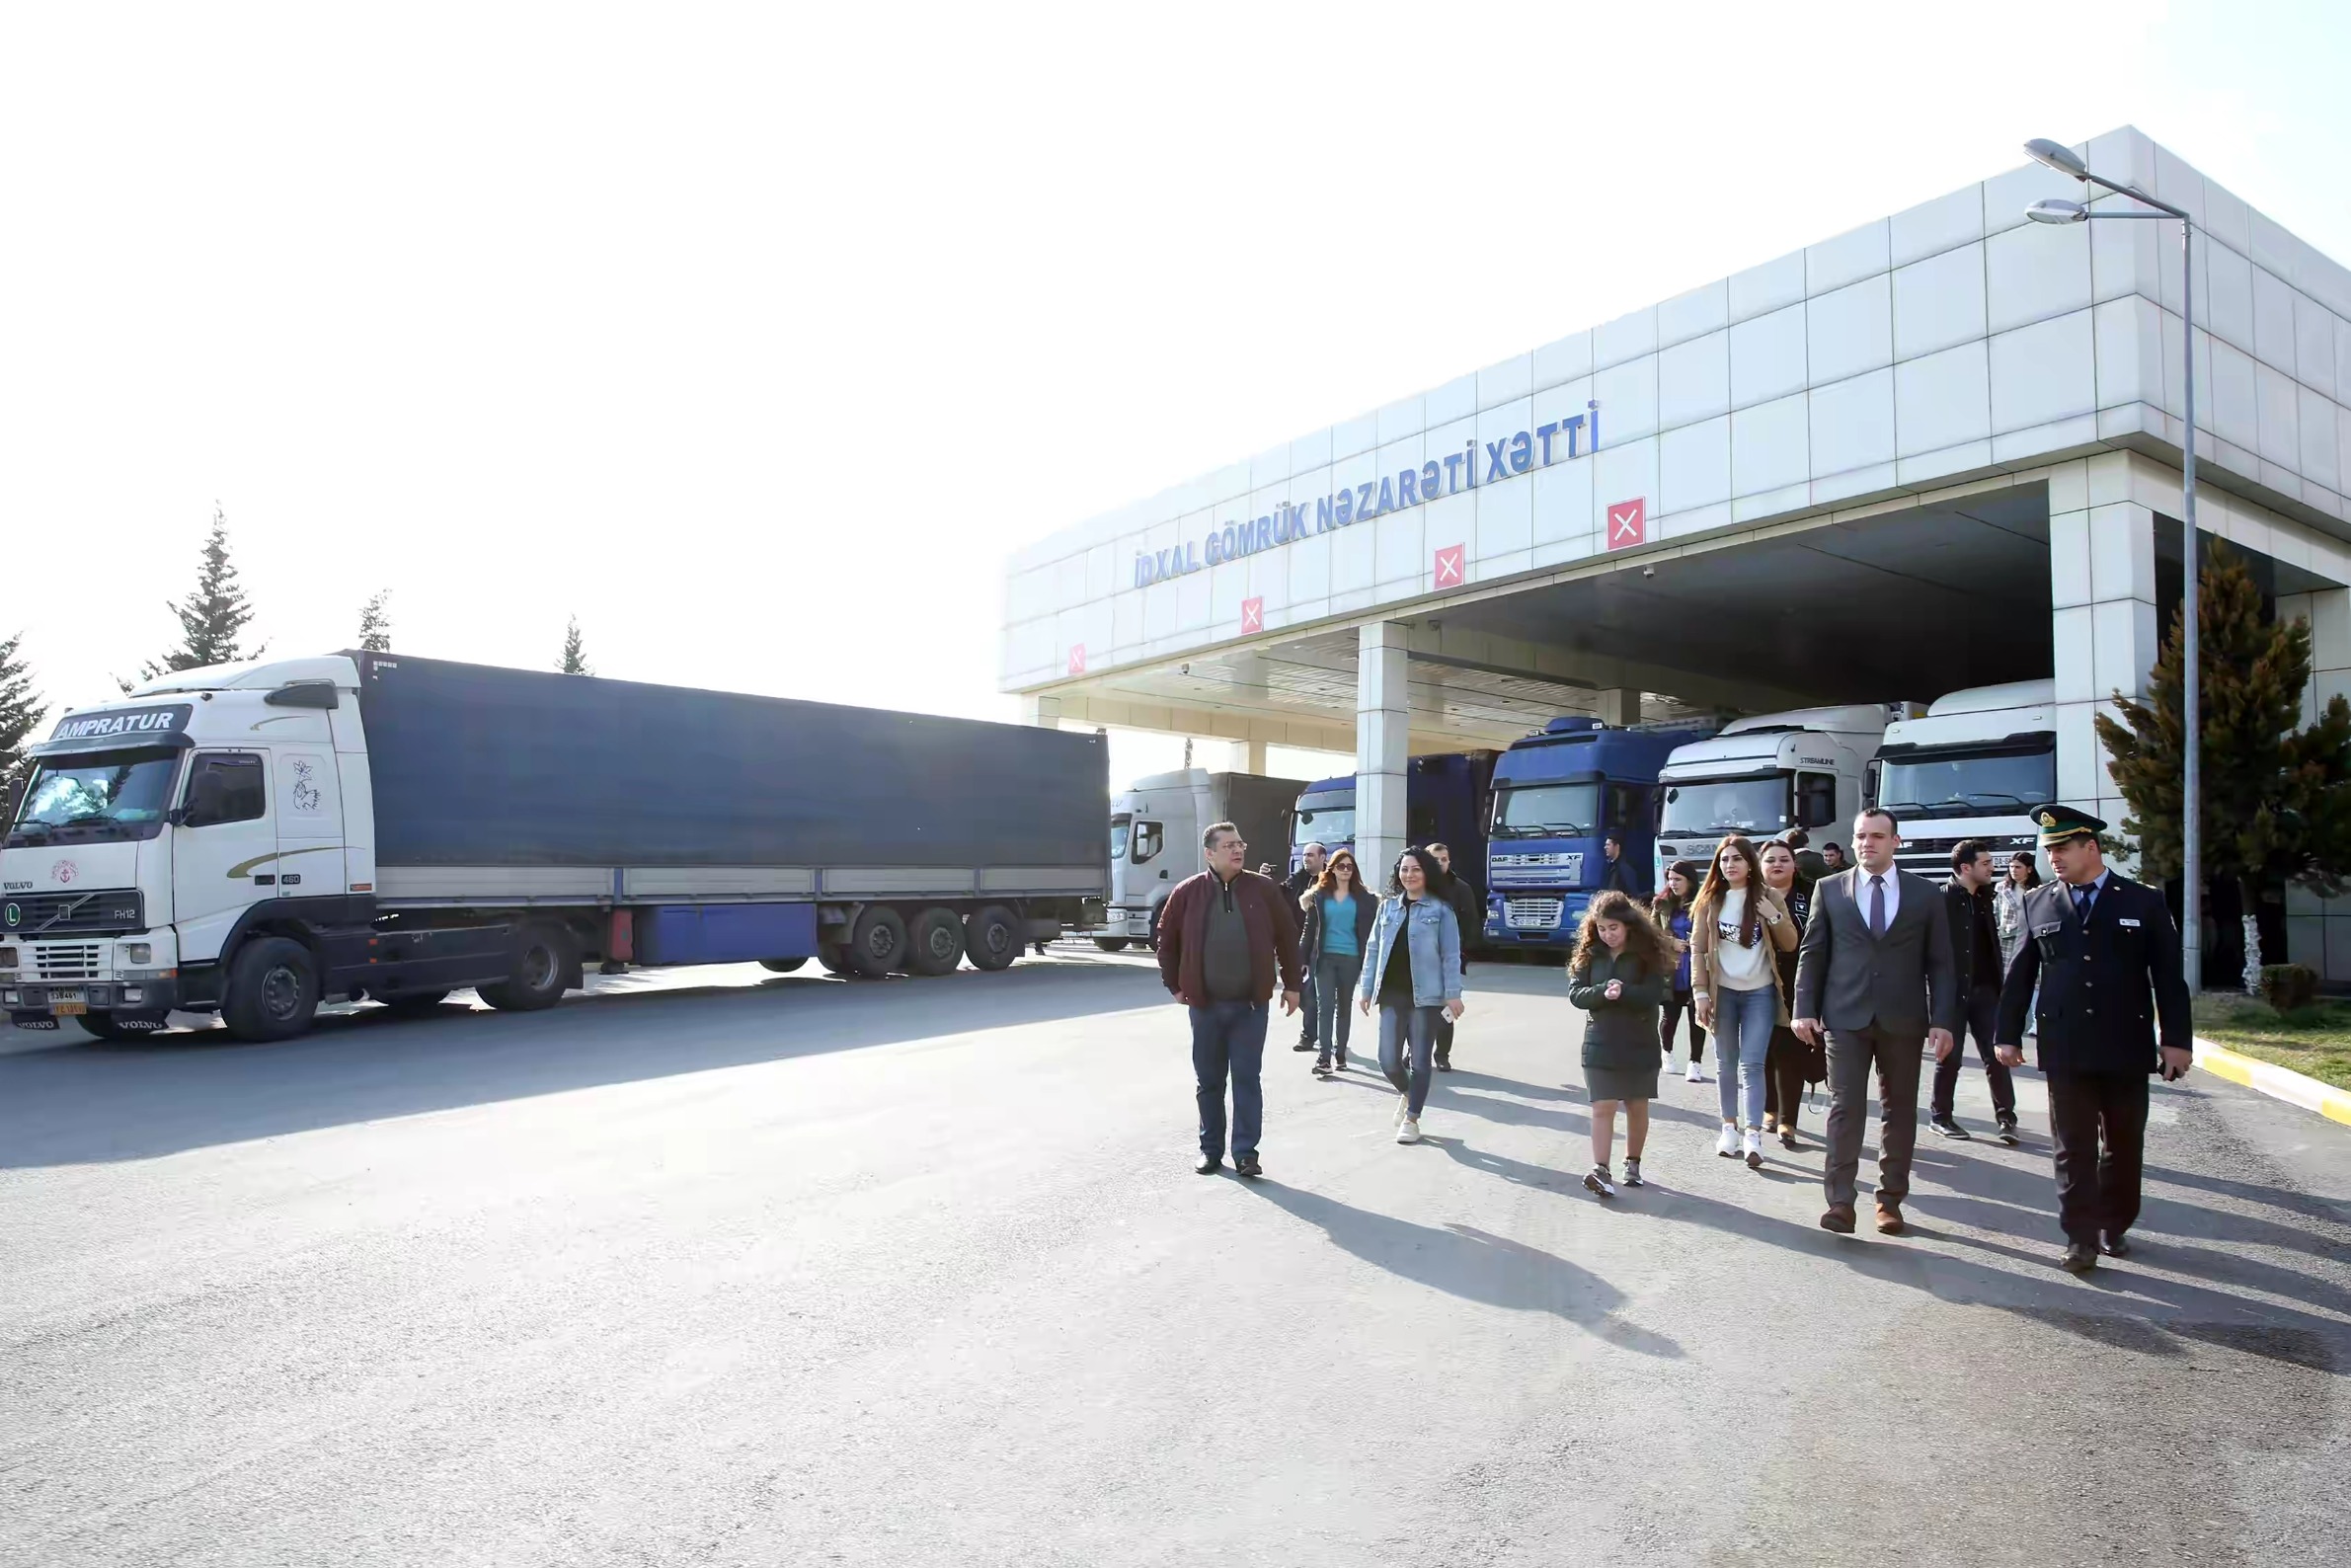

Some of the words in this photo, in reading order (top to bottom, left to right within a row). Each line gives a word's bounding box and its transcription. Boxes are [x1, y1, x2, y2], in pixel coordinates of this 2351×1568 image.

[1135, 540, 1200, 589] İDXAL
[1205, 501, 1310, 566] GÖMRÜK
[1316, 439, 1477, 533] NƏZARƏTİ
[1486, 399, 1600, 484] XƏTTİ
[56, 712, 175, 739] AMPRATUR
[1799, 757, 1836, 766] STREAMLINE
[3, 881, 34, 890] VOLVO
[114, 909, 136, 920] FH12
[18, 1020, 54, 1029] VOLVO
